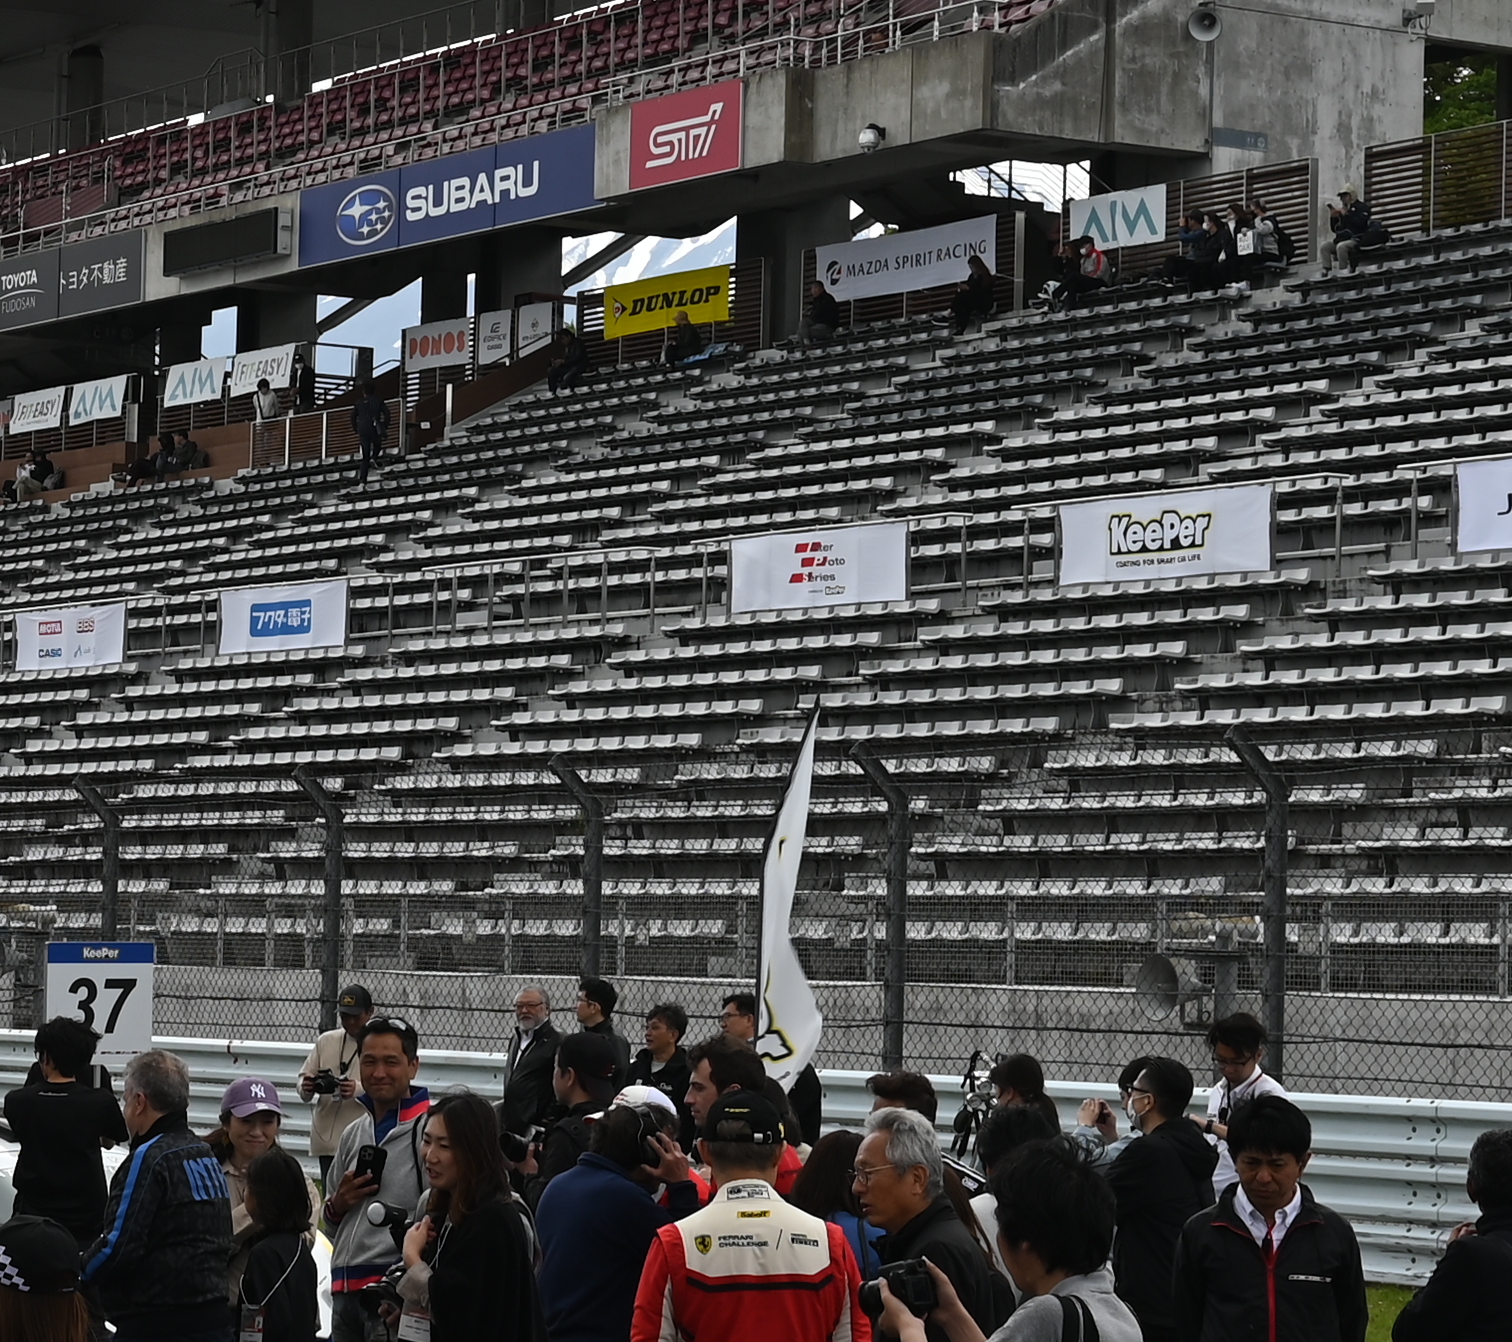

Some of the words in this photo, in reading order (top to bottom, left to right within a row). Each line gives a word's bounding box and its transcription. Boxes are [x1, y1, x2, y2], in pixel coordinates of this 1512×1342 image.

[405, 160, 540, 221] SUBARU
[846, 259, 890, 279] MAZDA
[894, 250, 933, 269] SPIRIT
[936, 239, 987, 260] RACING
[1, 269, 37, 291] TOYOTA
[1, 296, 36, 315] FUDOSAN
[628, 285, 721, 316] DUNLOP
[409, 329, 465, 360] PONOS
[1109, 510, 1212, 555] KeePer
[83, 947, 120, 959] KeePer
[68, 977, 138, 1034] 37
